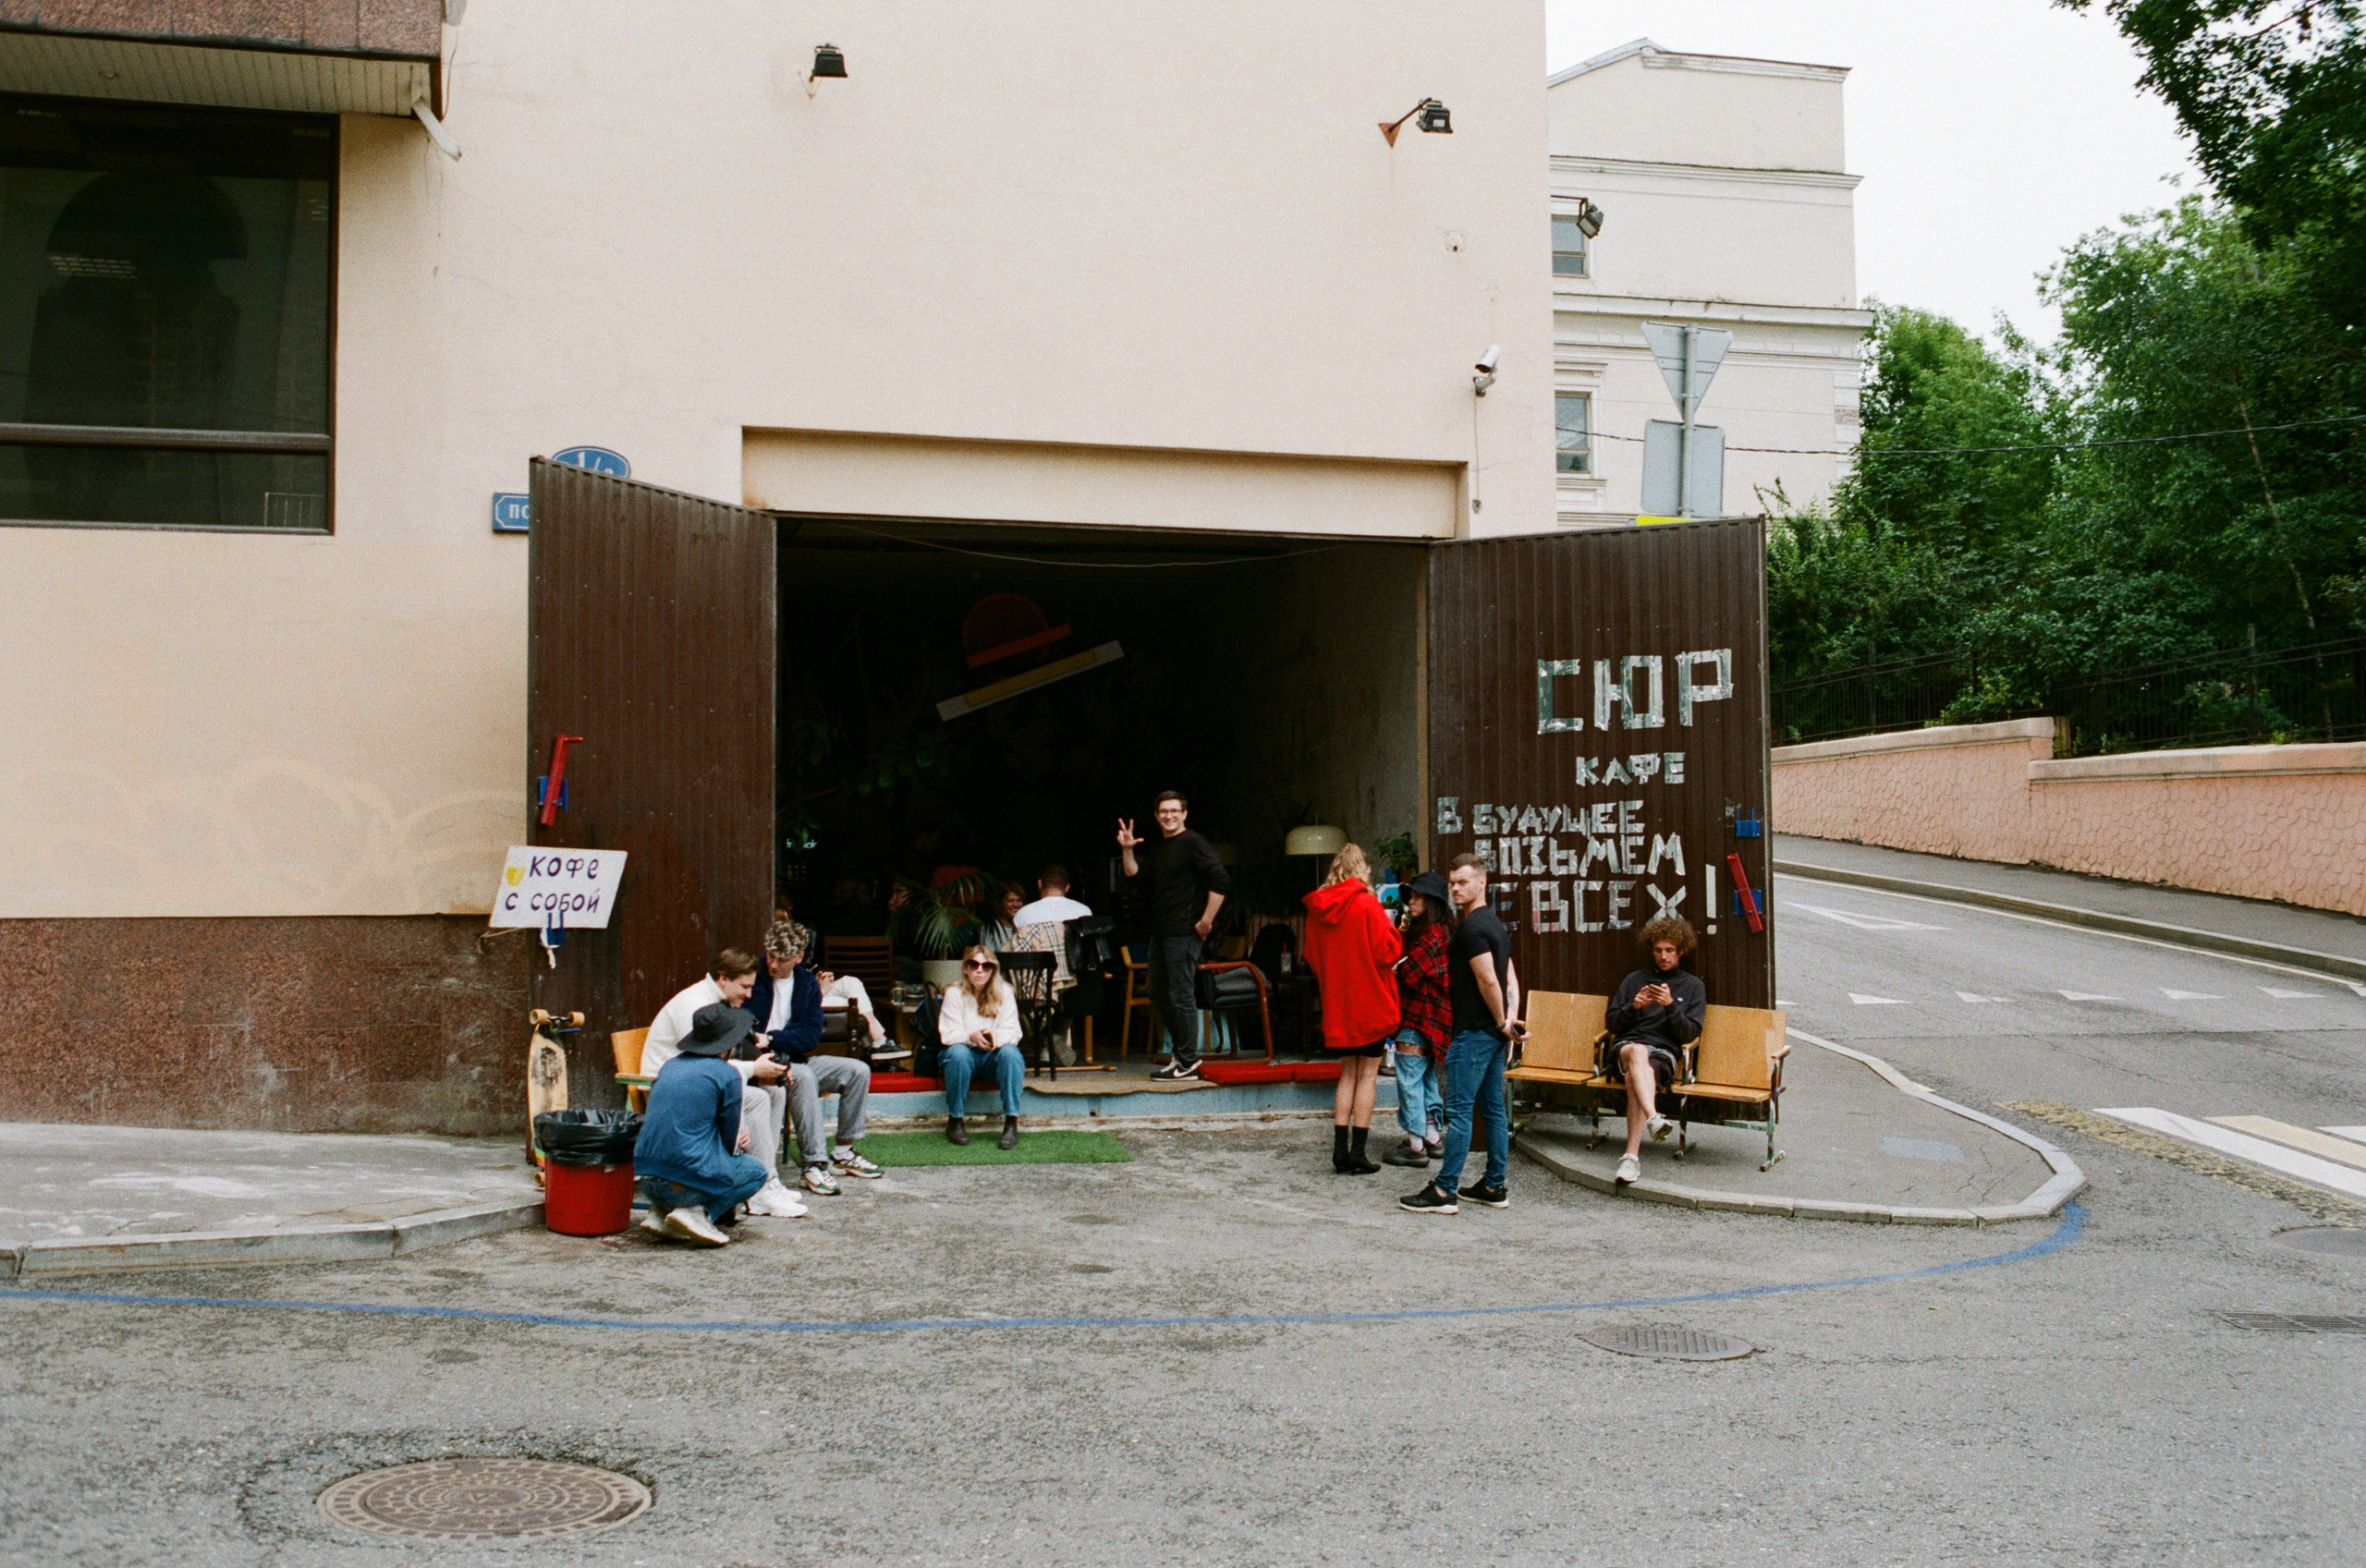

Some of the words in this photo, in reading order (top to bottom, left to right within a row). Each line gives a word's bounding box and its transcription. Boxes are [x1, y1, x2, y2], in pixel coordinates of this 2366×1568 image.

[1537, 649, 1734, 735] СЮР
[1576, 752, 1685, 786] КАФЕ
[1437, 796, 1463, 834] В
[1472, 799, 1645, 839] БУДУЩЕЕ
[530, 856, 599, 879] КОФЕ
[1474, 833, 1686, 878] ВОЗЬМЕМ
[505, 892, 518, 911] С
[531, 888, 600, 914] СОБОЙ
